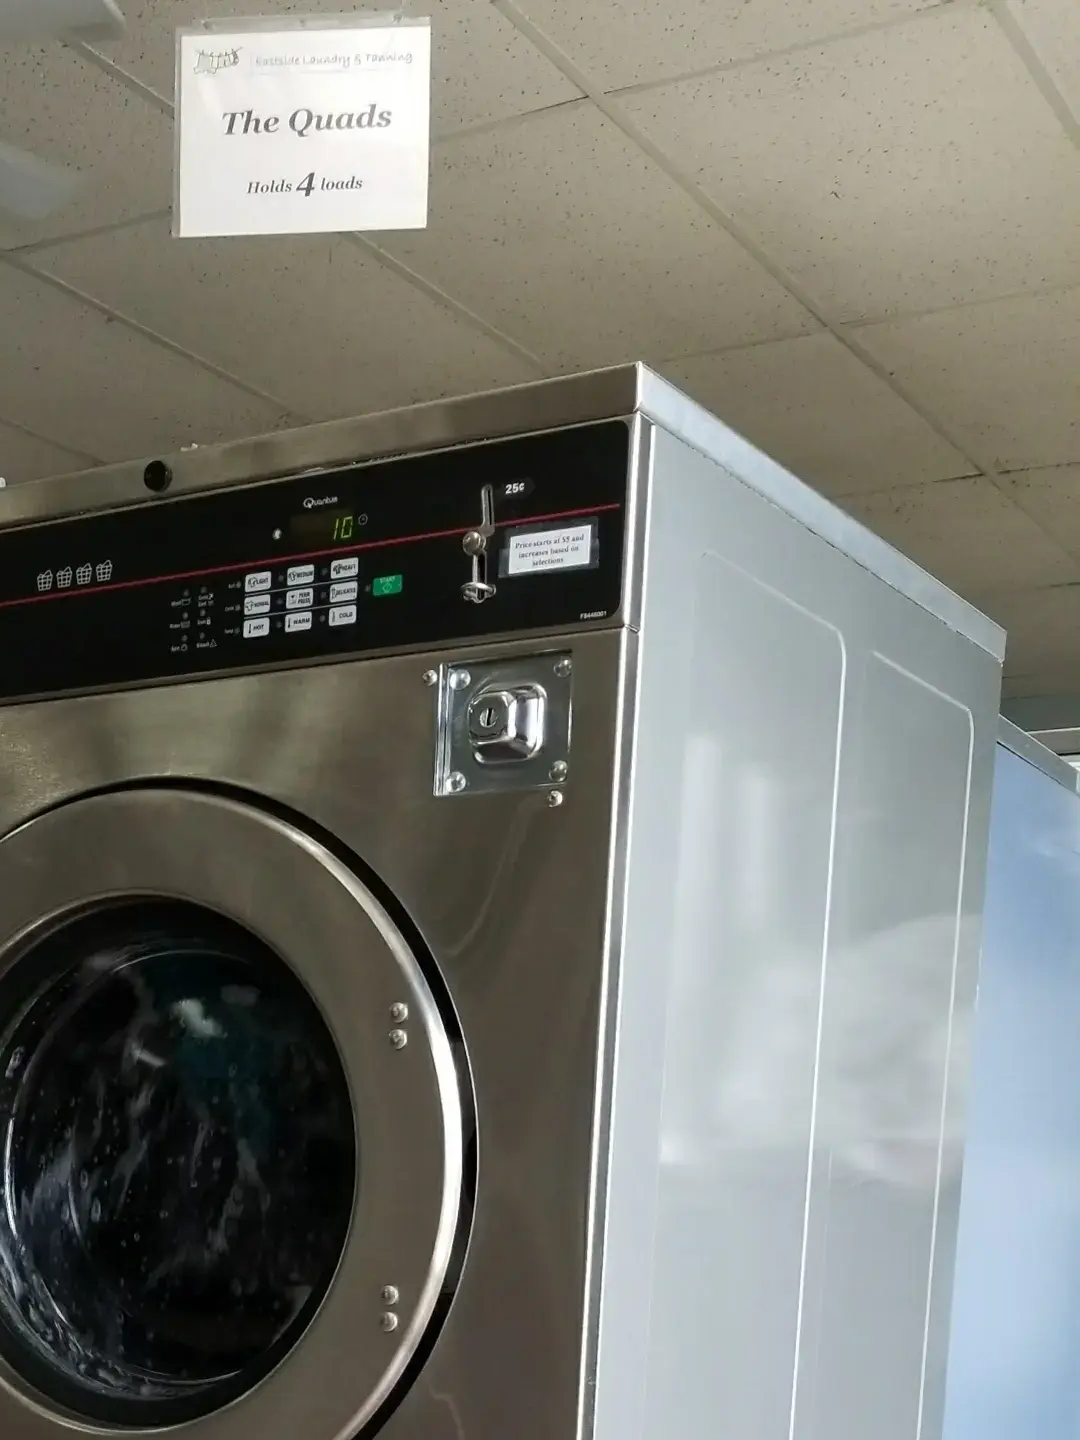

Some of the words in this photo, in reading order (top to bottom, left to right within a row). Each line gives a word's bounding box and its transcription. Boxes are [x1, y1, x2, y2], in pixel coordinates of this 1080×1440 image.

[302, 54, 350, 69] Laundry
[365, 52, 413, 65] Tanning
[222, 109, 280, 135] The
[288, 103, 392, 138] Quads
[247, 179, 292, 194] Holds
[295, 172, 316, 197] 4
[320, 176, 363, 191] loads
[332, 515, 354, 541] 10
[515, 540, 532, 550] Price
[533, 538, 552, 547] starts
[571, 533, 584, 542] and
[518, 549, 549, 559] increases
[550, 546, 569, 555] based
[532, 557, 564, 567] selections
[293, 617, 310, 625] WARM
[339, 611, 353, 619] COLD
